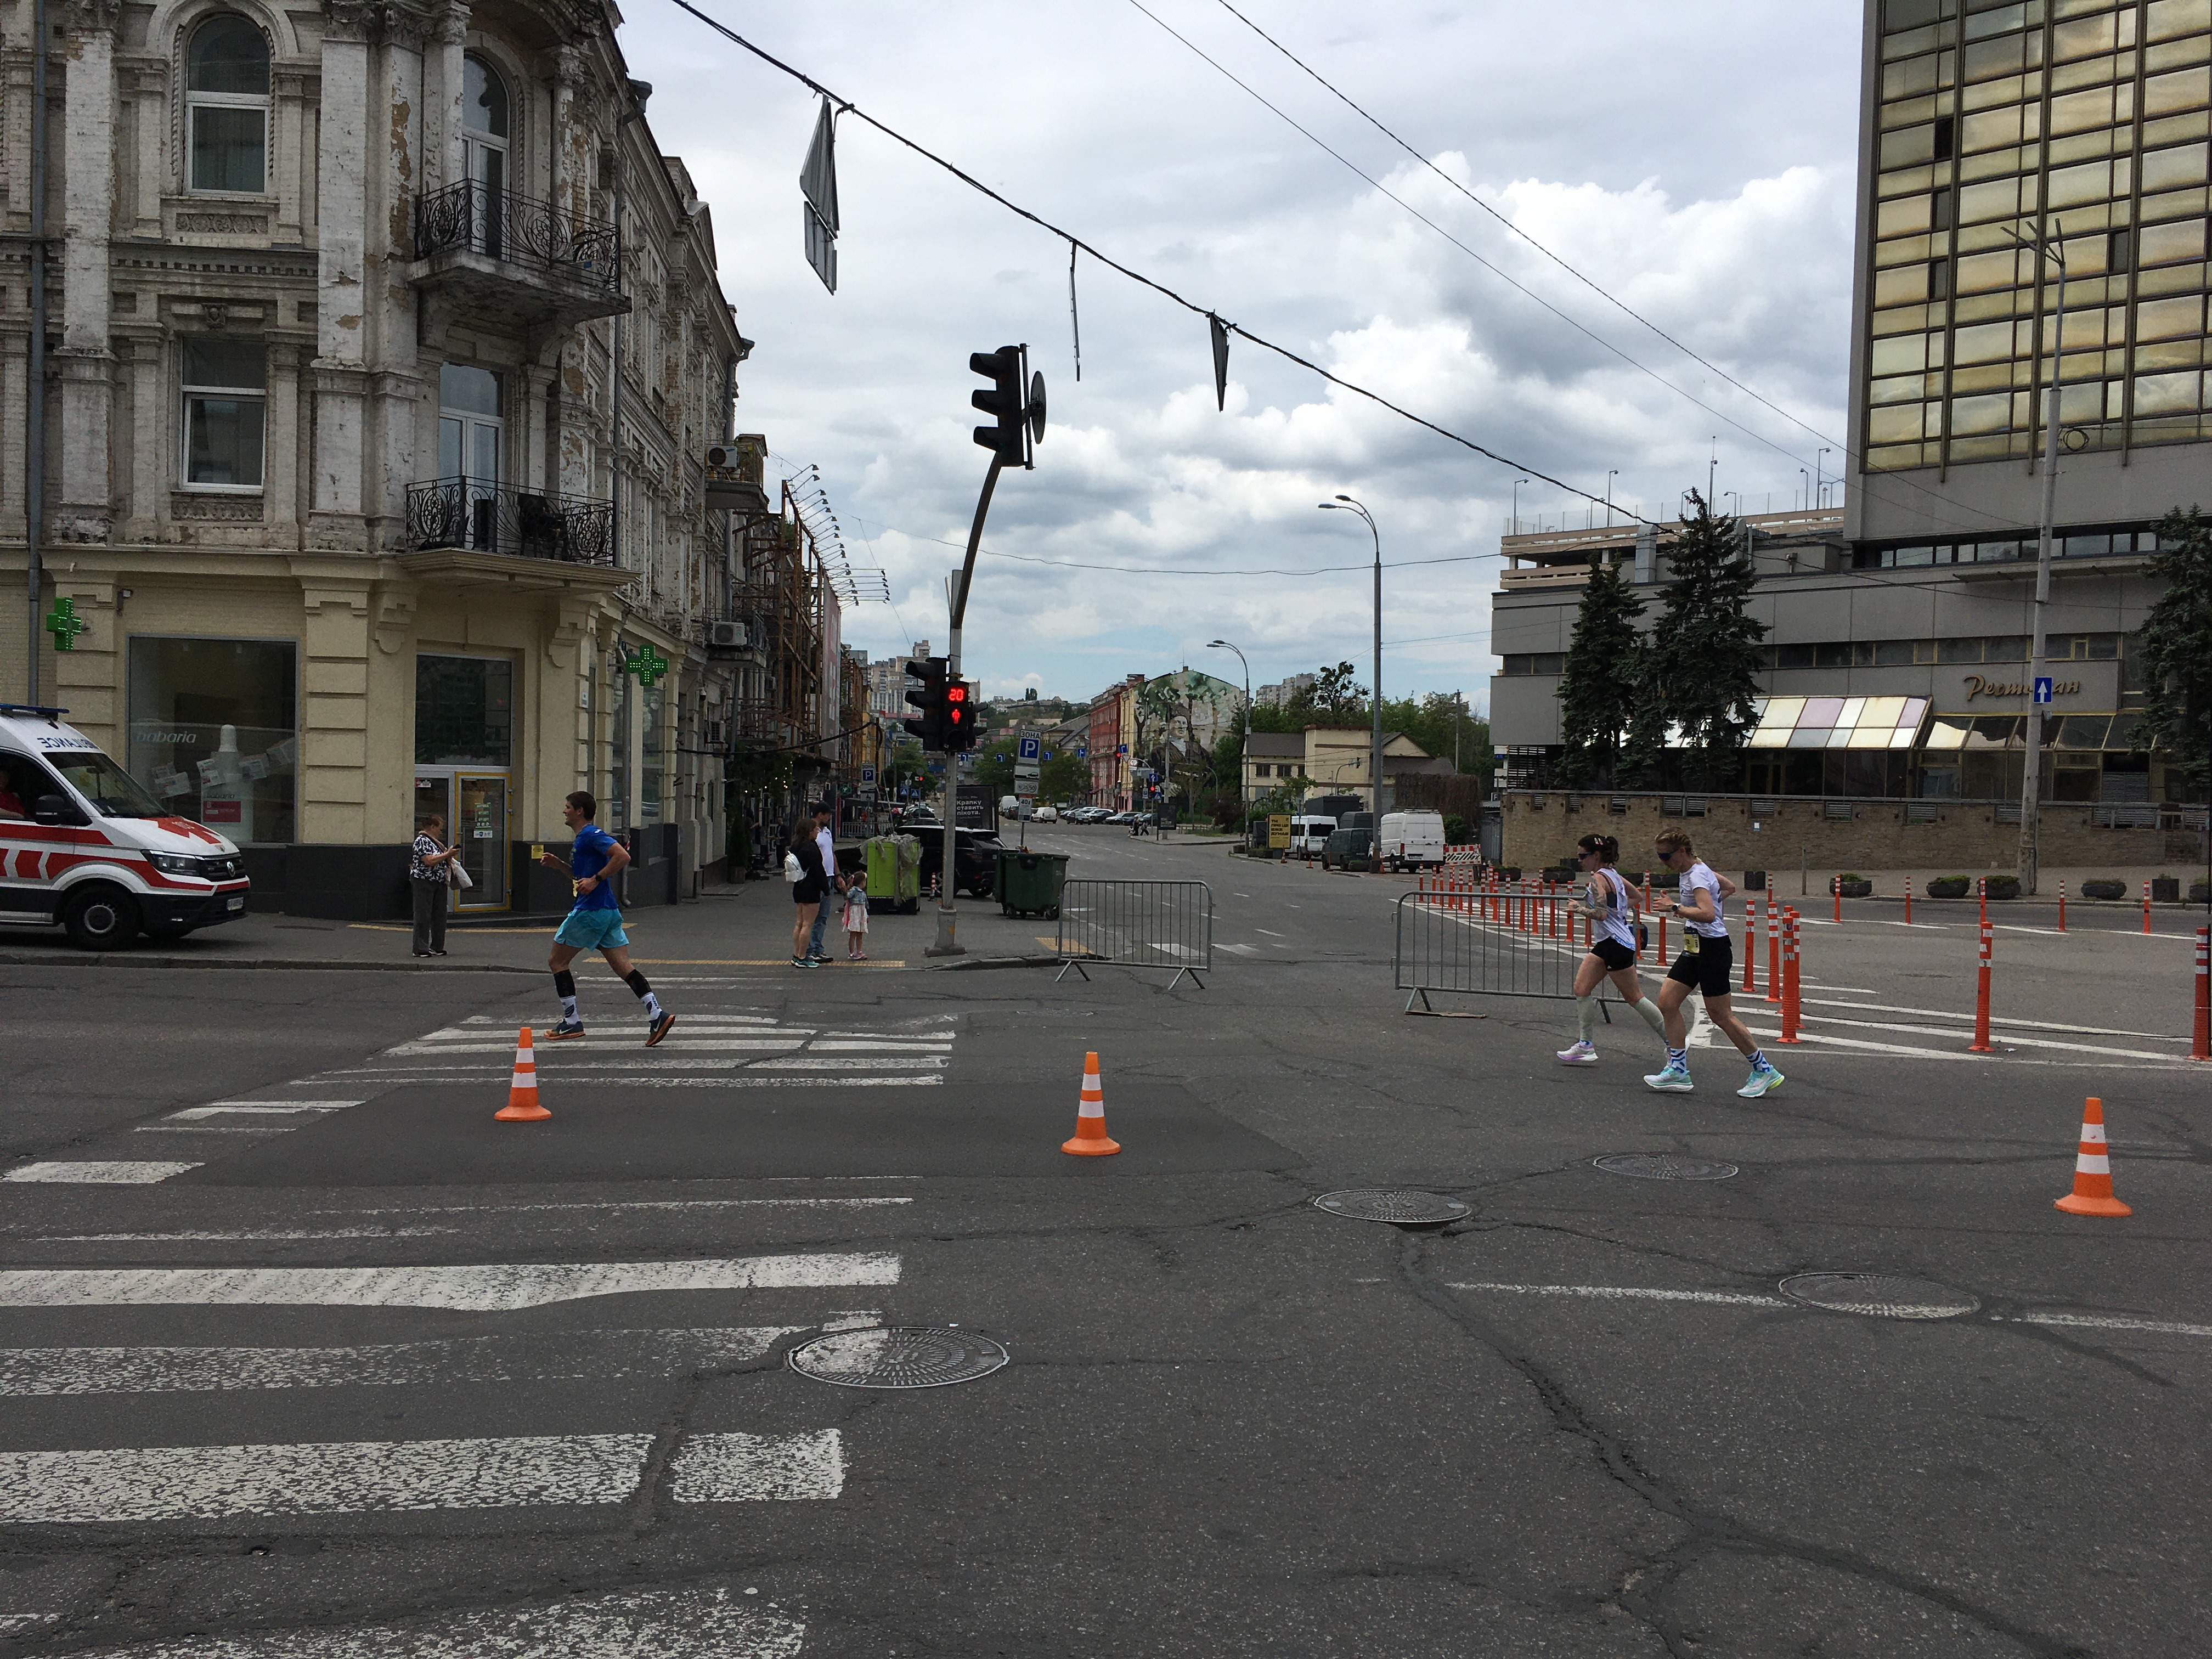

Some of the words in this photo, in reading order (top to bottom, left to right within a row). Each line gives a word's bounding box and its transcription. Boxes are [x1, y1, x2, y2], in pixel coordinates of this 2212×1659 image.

[949, 688, 964, 701] 20
[1963, 674, 2080, 702] Рестоан
[1020, 731, 1040, 740] ЗОНА
